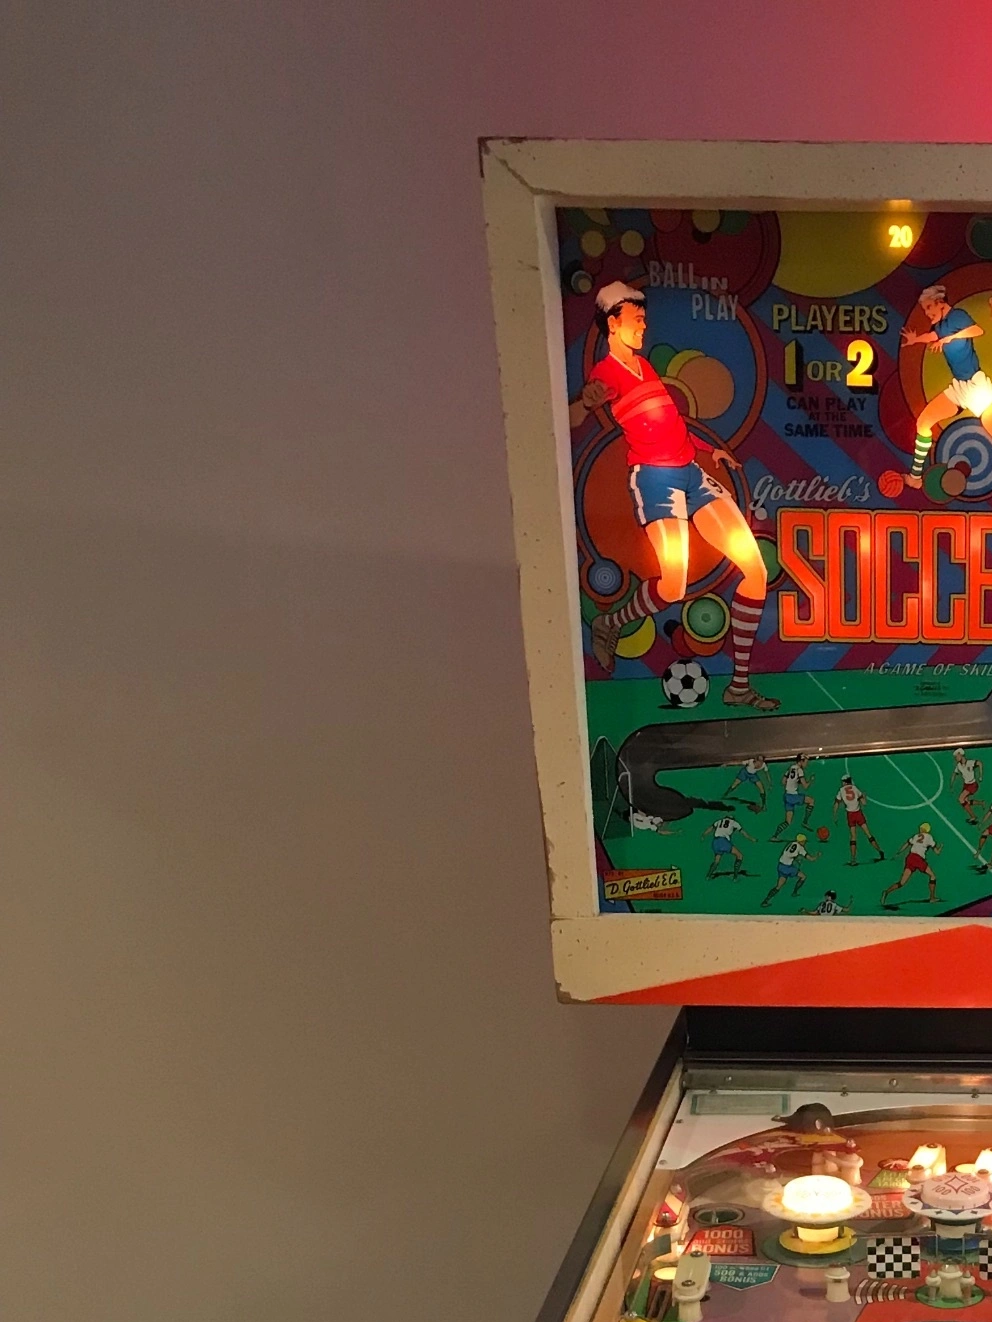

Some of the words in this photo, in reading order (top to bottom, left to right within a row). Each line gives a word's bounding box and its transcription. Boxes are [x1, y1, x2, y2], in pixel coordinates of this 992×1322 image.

[888, 224, 913, 248] 20
[649, 260, 698, 289] BALL
[701, 276, 729, 290] IN
[691, 293, 739, 321] PLAY
[772, 303, 888, 335] PLAYERS
[784, 341, 802, 390] 1
[806, 360, 842, 384] OR
[846, 339, 877, 390] 2
[786, 396, 819, 410] CAN
[825, 397, 867, 411] PLAY
[808, 411, 820, 421] AT
[824, 411, 847, 422] THE
[784, 423, 830, 438] SAME
[833, 424, 873, 438] TIME
[749, 475, 871, 510] Gottlieb's
[864, 662, 876, 675] A
[878, 662, 930, 676] GAME
[933, 663, 954, 676] OF
[718, 818, 730, 829] 18
[785, 843, 798, 854] 19
[623, 875, 660, 895] Gottlieb
[703, 1230, 744, 1239] 1000
[690, 1243, 751, 1254] BONUS
